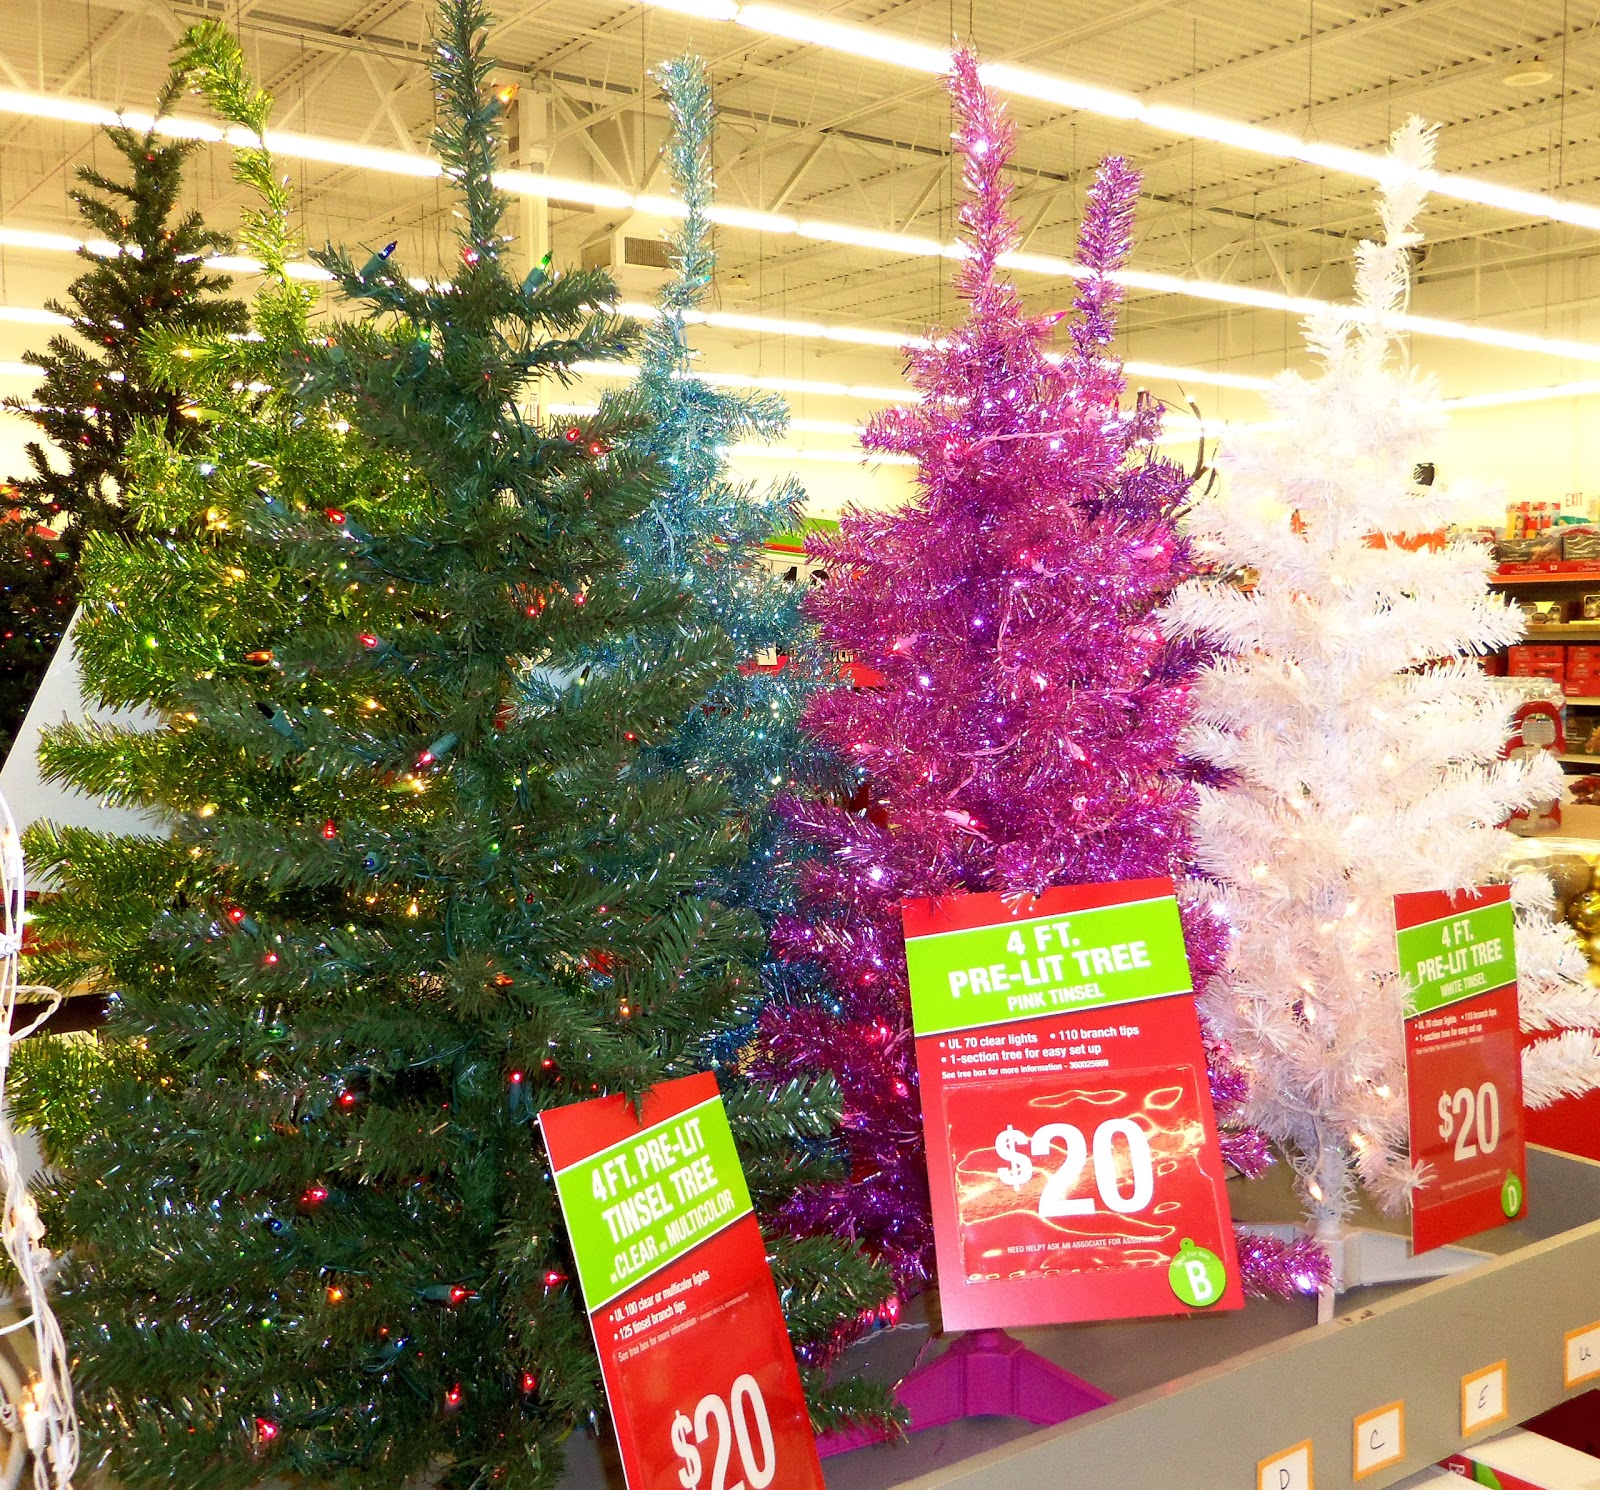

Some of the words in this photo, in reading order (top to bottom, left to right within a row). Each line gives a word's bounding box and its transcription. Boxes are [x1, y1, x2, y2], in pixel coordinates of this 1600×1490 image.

[1565, 492, 1583, 507] EXIT
[1006, 930, 1025, 955] 4
[1033, 921, 1080, 951] FT.
[1442, 925, 1451, 947] 4
[1453, 919, 1474, 945] FT.
[948, 954, 1064, 999] PRE-LIT
[1072, 940, 1151, 976] TREE
[1417, 947, 1467, 983] PRE-LIT
[1470, 937, 1503, 967] TREE
[1007, 991, 1046, 1012] PINK
[1048, 983, 1105, 1005] TINSEL
[1440, 979, 1462, 998] WHITE
[1463, 971, 1487, 989] TINSEL
[947, 1038, 962, 1049] UL
[964, 1037, 977, 1048] 70
[980, 1036, 1006, 1047] clear
[1008, 1032, 1038, 1046] lights
[1059, 1029, 1078, 1040] 110
[1080, 1027, 1117, 1039] branch
[1119, 1025, 1139, 1037] tips
[950, 1051, 999, 1064] 1-section
[1001, 1049, 1022, 1061] tree
[1024, 1047, 1040, 1058] for
[1042, 1047, 1066, 1058] easy
[1069, 1044, 1086, 1055] set
[1088, 1044, 1102, 1055] up
[942, 1071, 956, 1079] See
[957, 1070, 971, 1078] tree
[973, 1069, 986, 1077] box
[988, 1067, 998, 1075] for
[1000, 1067, 1019, 1075] more
[1020, 1062, 1062, 1073] information
[1438, 1081, 1500, 1162] $20
[591, 1168, 607, 1202] 4
[602, 1153, 638, 1196] FT.
[634, 1116, 705, 1180] PRE-LIT
[994, 1118, 1154, 1218] $20
[601, 1181, 674, 1244] TINSEL
[668, 1154, 718, 1205] TREE
[1507, 1184, 1518, 1213] D
[614, 1234, 659, 1279] CLEAR
[664, 1188, 735, 1247] MULTICOLOR
[1007, 1245, 1024, 1254] NEED
[1025, 1244, 1046, 1252] HELP?
[1047, 1242, 1061, 1250] ASK
[1072, 1239, 1107, 1249] ASSOCIATE
[1108, 1237, 1121, 1246] FOR
[1184, 1259, 1213, 1300] B
[614, 1307, 625, 1322] UL
[624, 1300, 638, 1316] 100
[638, 1295, 654, 1311] clear
[655, 1291, 662, 1303] or
[662, 1278, 693, 1299] multicolor
[692, 1269, 710, 1286] lights
[619, 1324, 633, 1340] 125
[632, 1314, 652, 1334] tinsel
[651, 1304, 674, 1325] branch
[673, 1300, 687, 1315] tips
[1477, 1384, 1490, 1409] E
[671, 1373, 776, 1490] $20
[1369, 1429, 1386, 1450] C
[1279, 1468, 1291, 1490] D
